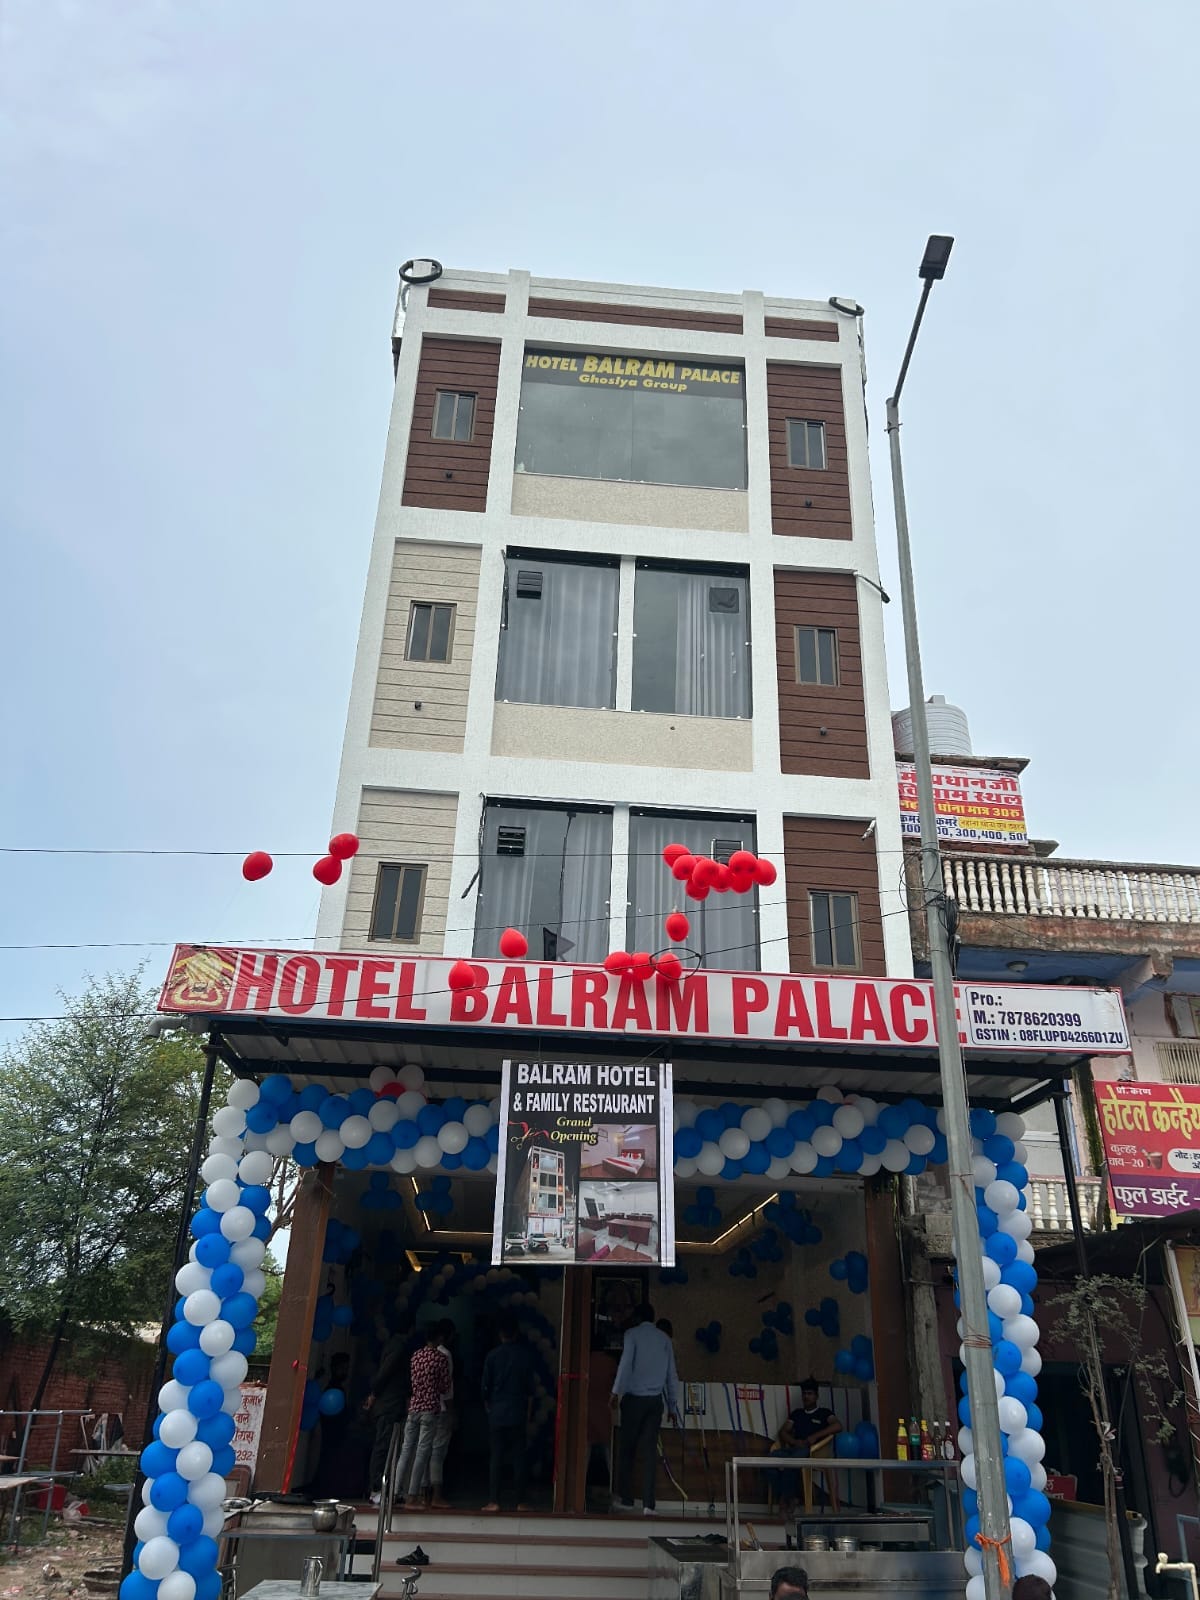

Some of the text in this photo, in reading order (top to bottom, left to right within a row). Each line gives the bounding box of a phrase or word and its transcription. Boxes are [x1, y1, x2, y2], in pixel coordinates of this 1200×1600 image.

[525, 355, 741, 385] HOTEL BALRAM PALACE
[642, 379, 688, 392] Group
[231, 952, 426, 1021] HOTEL
[449, 964, 709, 1033] BALRAM
[998, 1011, 1082, 1027] 7878620399
[975, 1028, 1010, 1041] GSTIN
[517, 1063, 656, 1087] BALRAM HOTEL
[513, 1092, 655, 1114] & FAMILY RESTAURANT
[1100, 1084, 1150, 1136] होटल
[556, 1116, 594, 1128] Grand
[550, 1130, 599, 1145] Opening
[1113, 1186, 1148, 1209] फुल
[1149, 1182, 1191, 1209] डाईट
